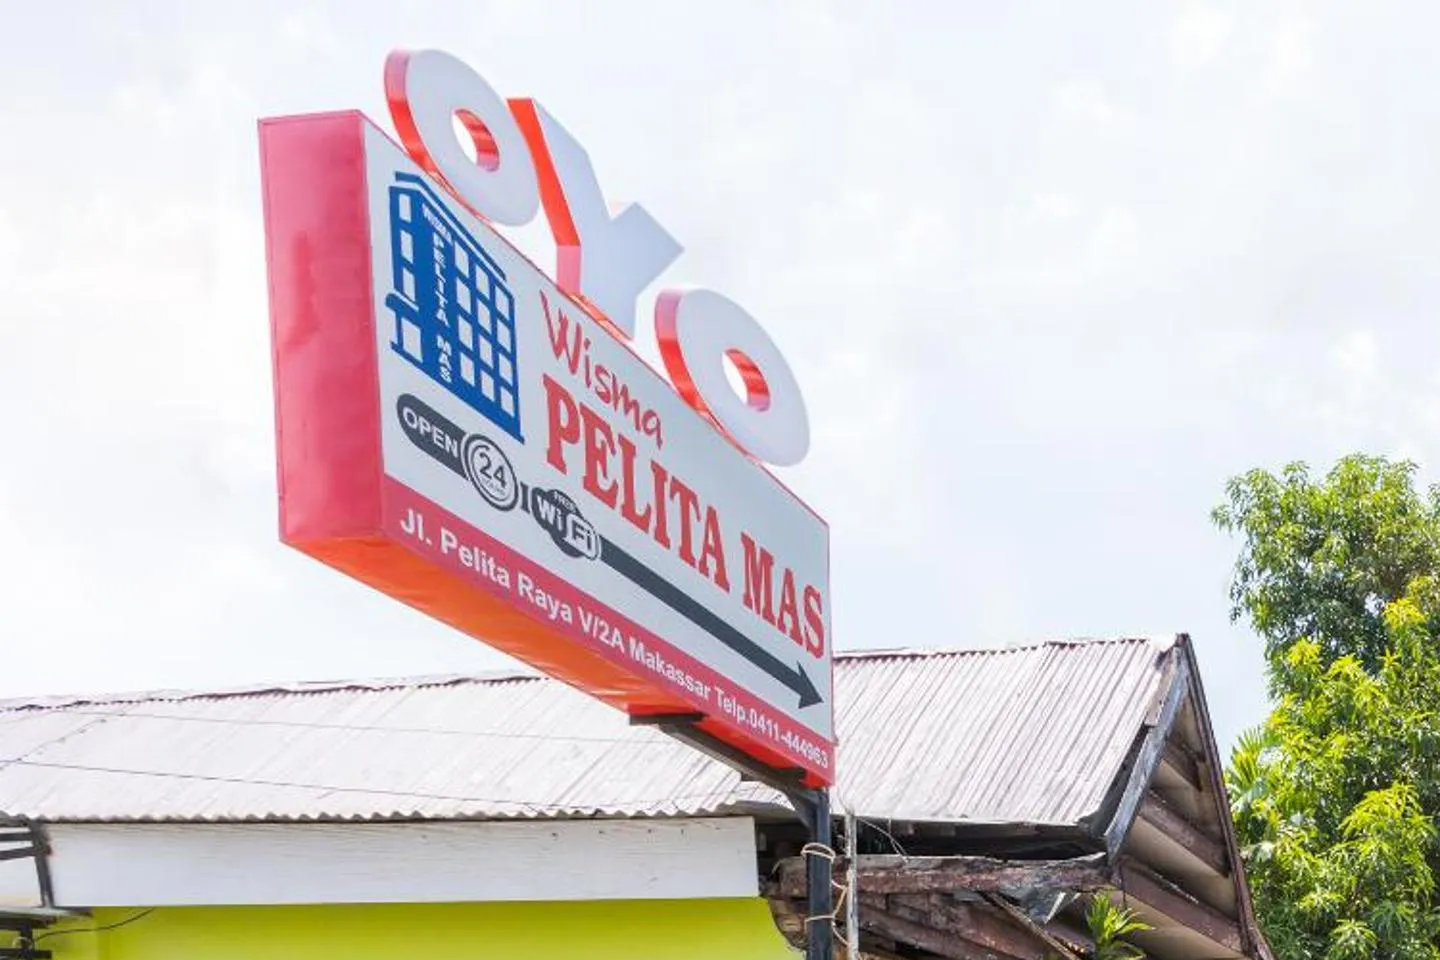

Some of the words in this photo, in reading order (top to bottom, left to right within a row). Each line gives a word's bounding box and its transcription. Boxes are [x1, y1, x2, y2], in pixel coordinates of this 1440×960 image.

[385, 48, 810, 463] OYO
[433, 231, 451, 326] PELITA
[437, 334, 453, 383] MAS
[541, 289, 664, 448] Wisma
[402, 406, 459, 458] OPEN
[479, 451, 508, 489] 24
[543, 373, 731, 594] PELITA
[740, 531, 825, 660] MAS
[401, 508, 433, 546] Jl.
[440, 527, 511, 589] Pelita
[517, 571, 573, 625] Raya
[577, 605, 625, 653] V/2A
[629, 636, 711, 701] Makassar
